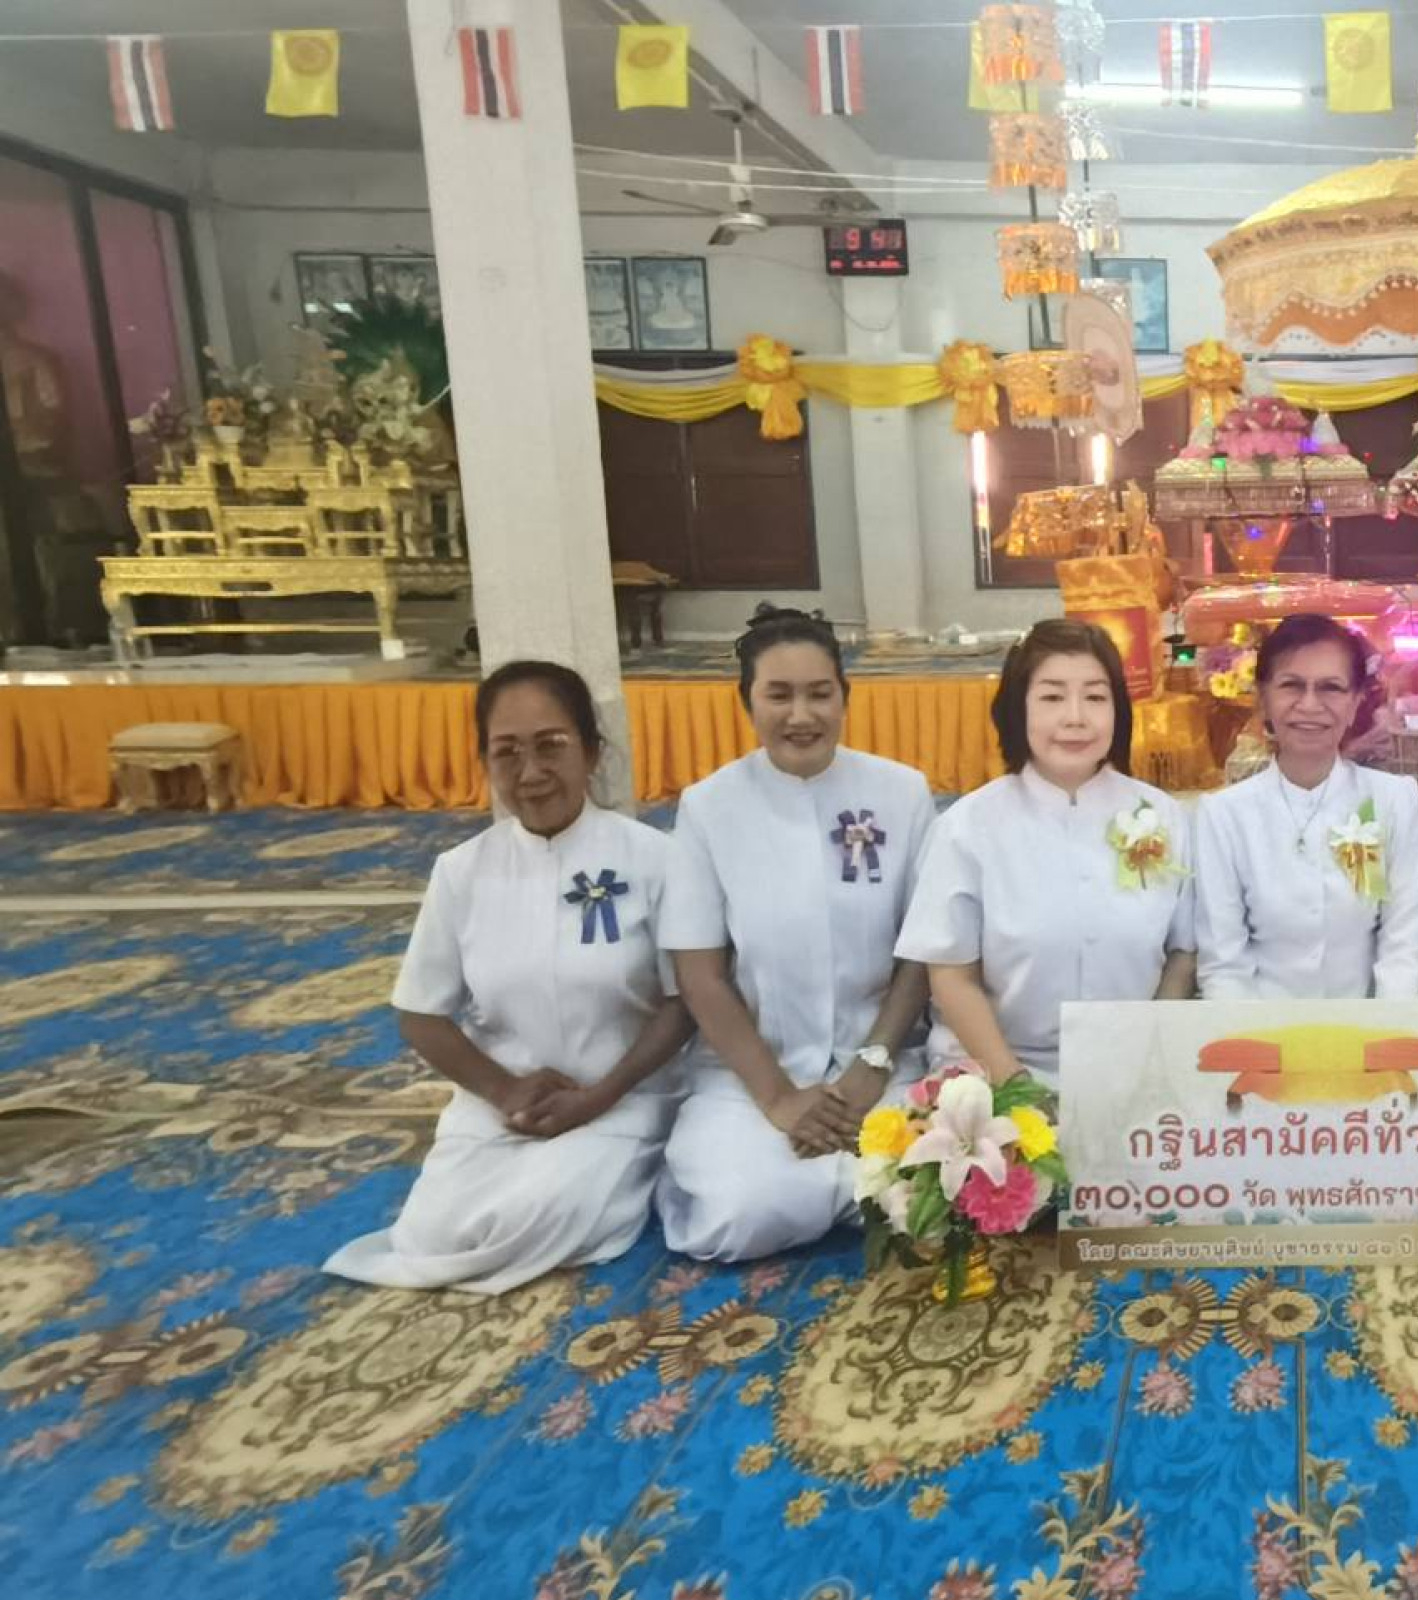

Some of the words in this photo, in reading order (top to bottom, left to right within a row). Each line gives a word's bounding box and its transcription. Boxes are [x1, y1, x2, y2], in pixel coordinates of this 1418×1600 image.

[1074, 1183, 1231, 1214] ๓๐,๐๐๐
[1242, 1179, 1277, 1207] วัด
[1077, 1239, 1116, 1261] โดย
